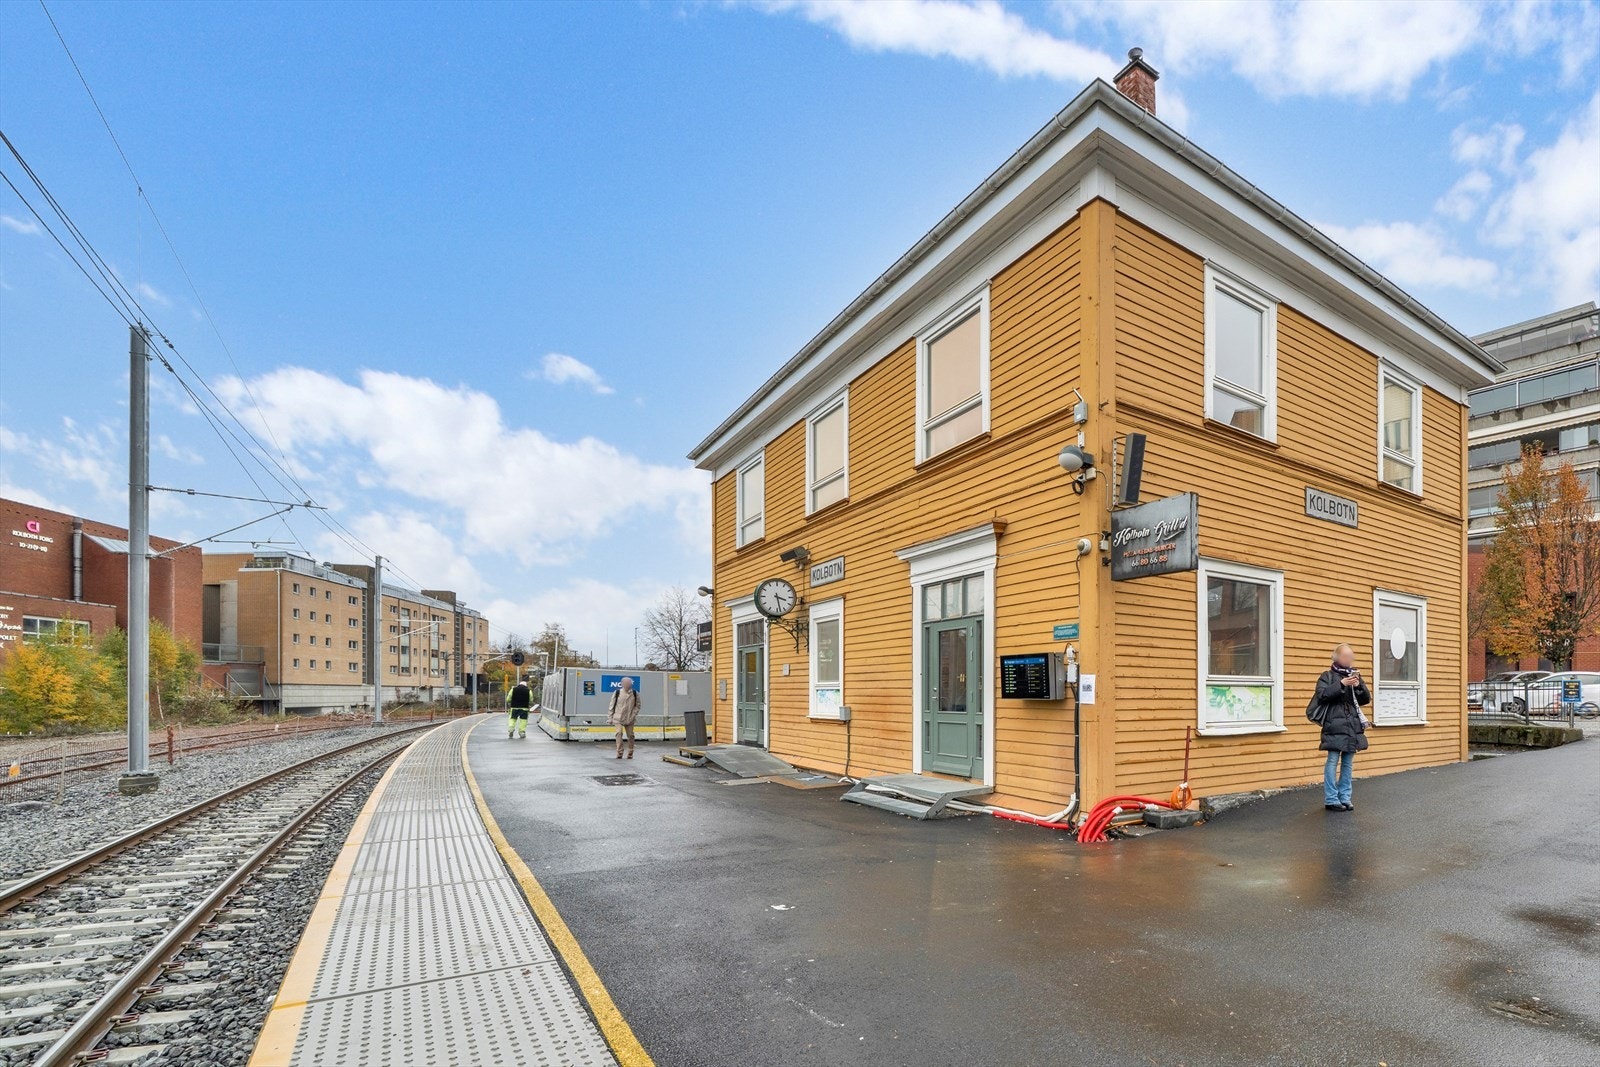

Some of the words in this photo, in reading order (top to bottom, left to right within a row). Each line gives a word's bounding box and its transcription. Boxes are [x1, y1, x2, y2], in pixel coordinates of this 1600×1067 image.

[1309, 493, 1355, 521] KOLBOTN
[1112, 527, 1150, 547] Kolbotn
[1149, 556, 1158, 564] 66
[812, 561, 842, 582] KOLBOTN
